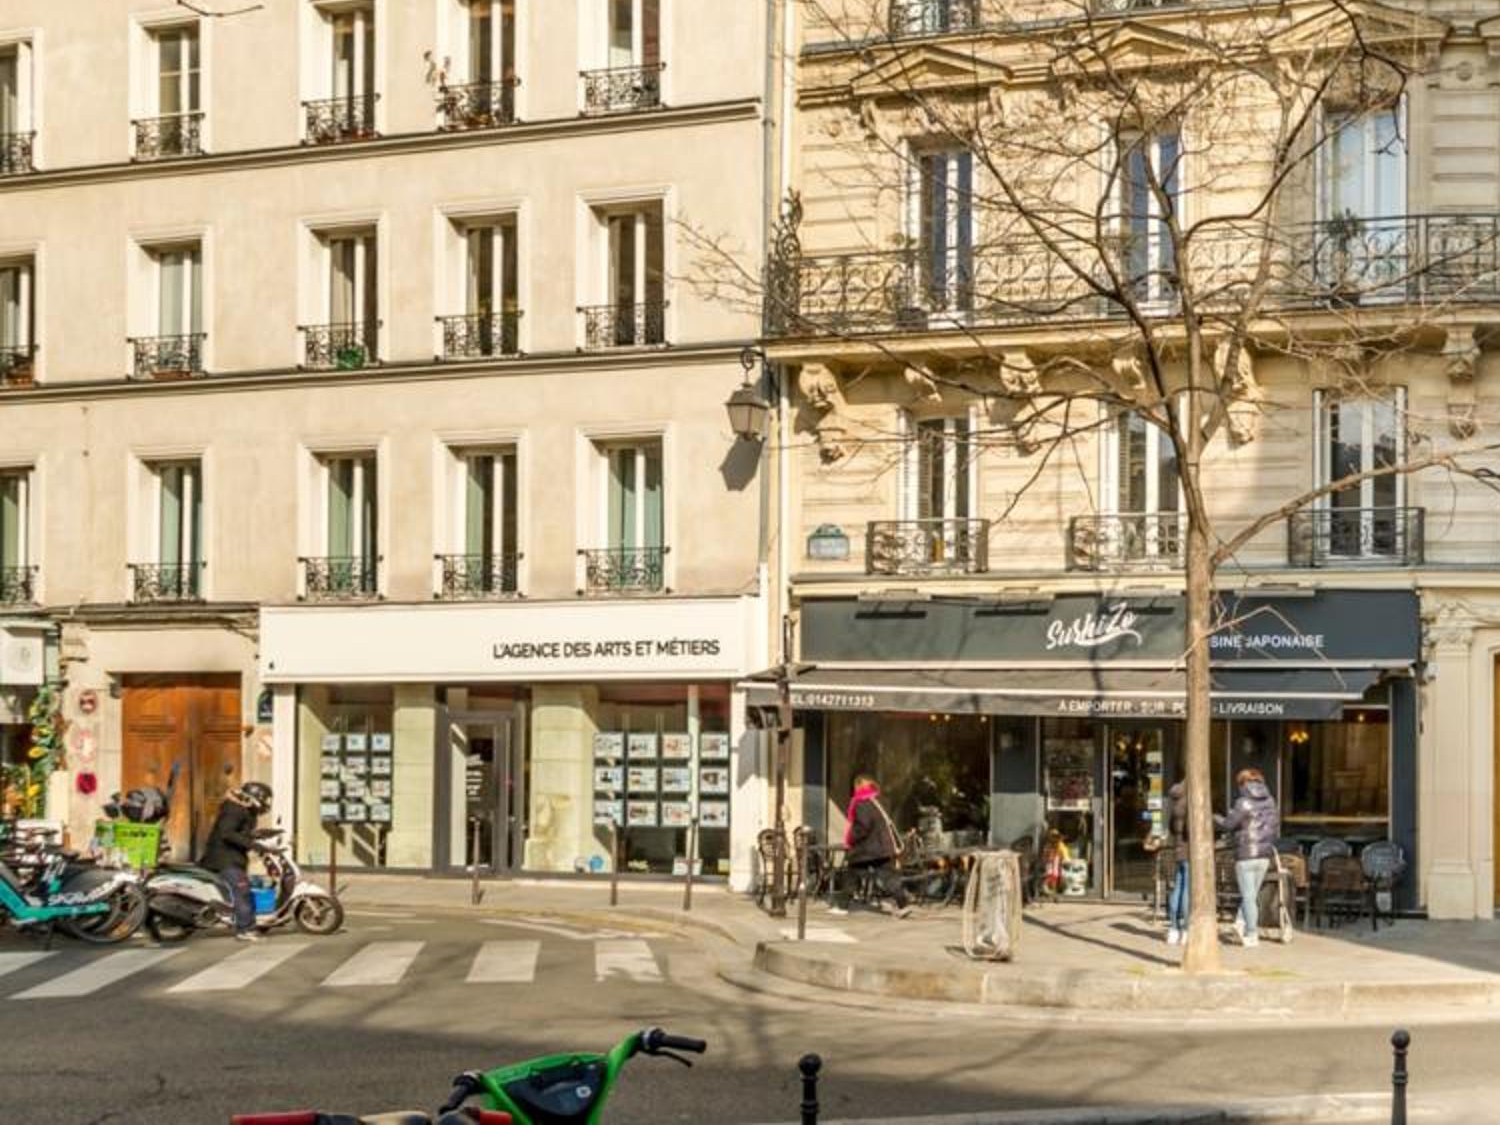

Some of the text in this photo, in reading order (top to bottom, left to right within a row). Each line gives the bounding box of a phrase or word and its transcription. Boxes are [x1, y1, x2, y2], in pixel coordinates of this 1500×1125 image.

[493, 637, 721, 659] L'AGENCE DES ARTS ET MÉTIERS
[1245, 634, 1325, 648] JAPONAISE
[1219, 702, 1284, 716] LIVRAISON
